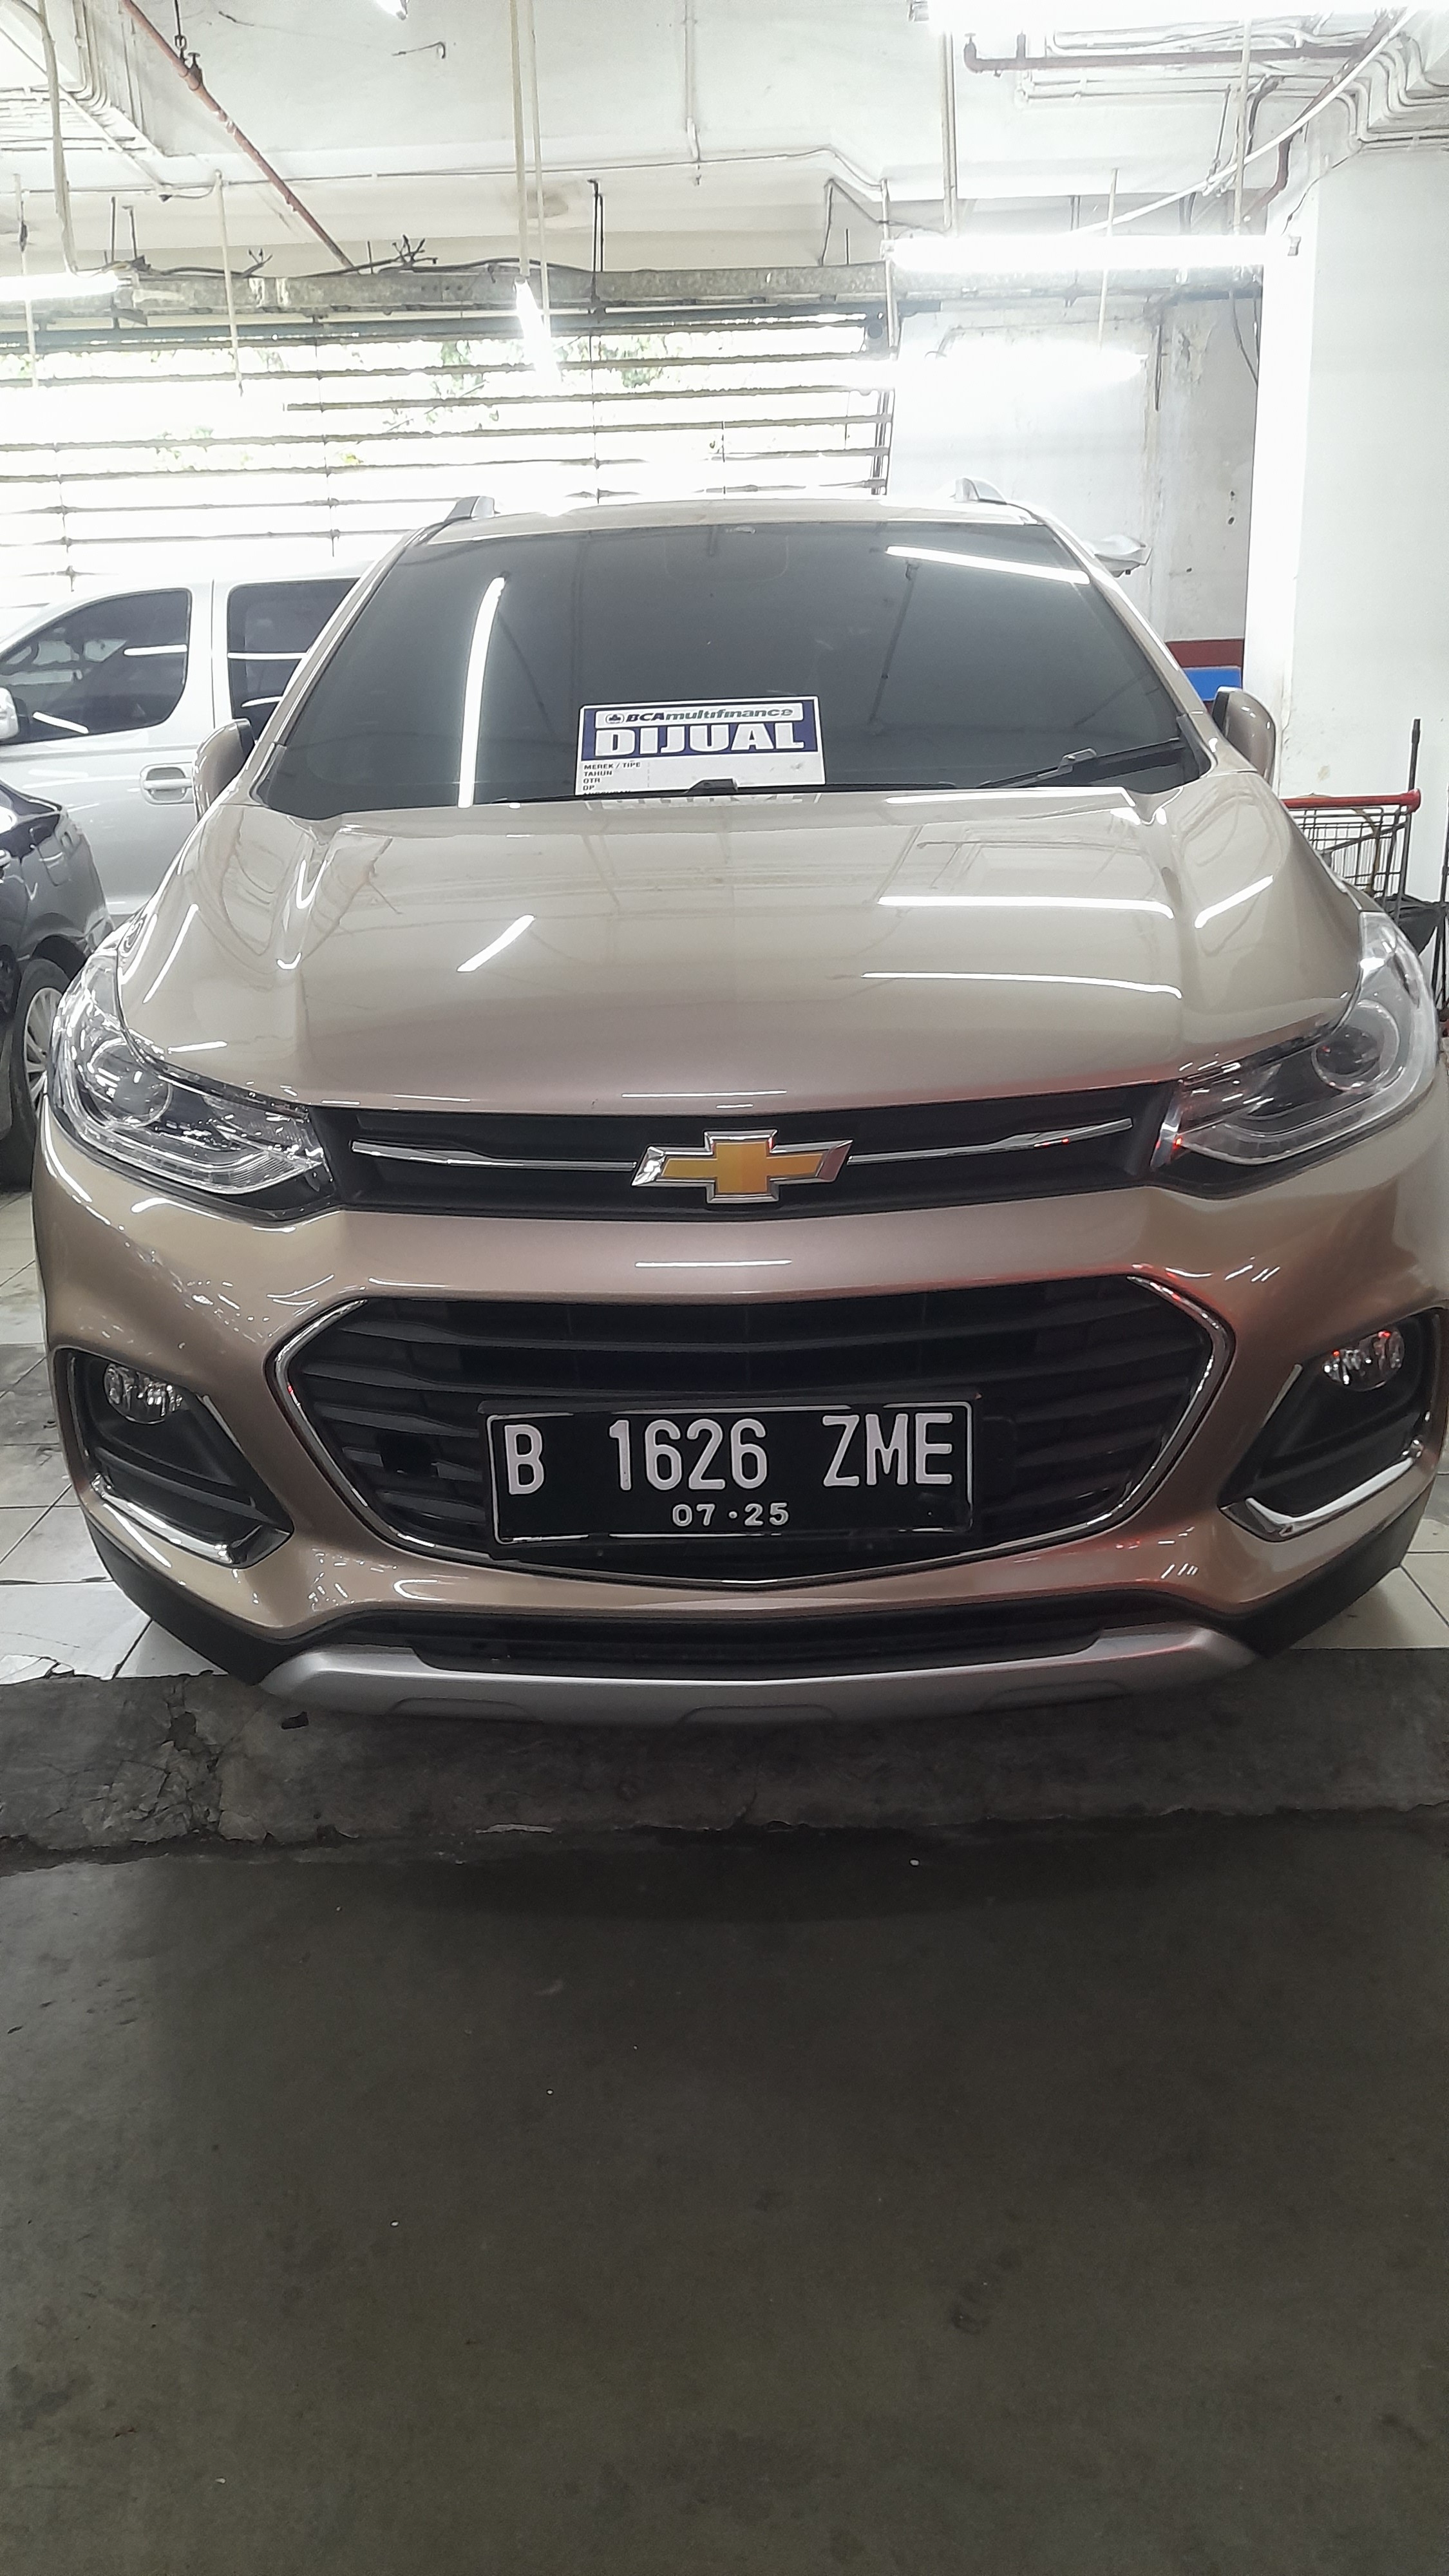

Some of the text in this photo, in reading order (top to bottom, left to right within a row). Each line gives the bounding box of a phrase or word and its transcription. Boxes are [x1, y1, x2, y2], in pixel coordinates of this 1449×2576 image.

[595, 723, 804, 757] DIJUAL
[505, 1413, 953, 1495] B 1626 ZME
